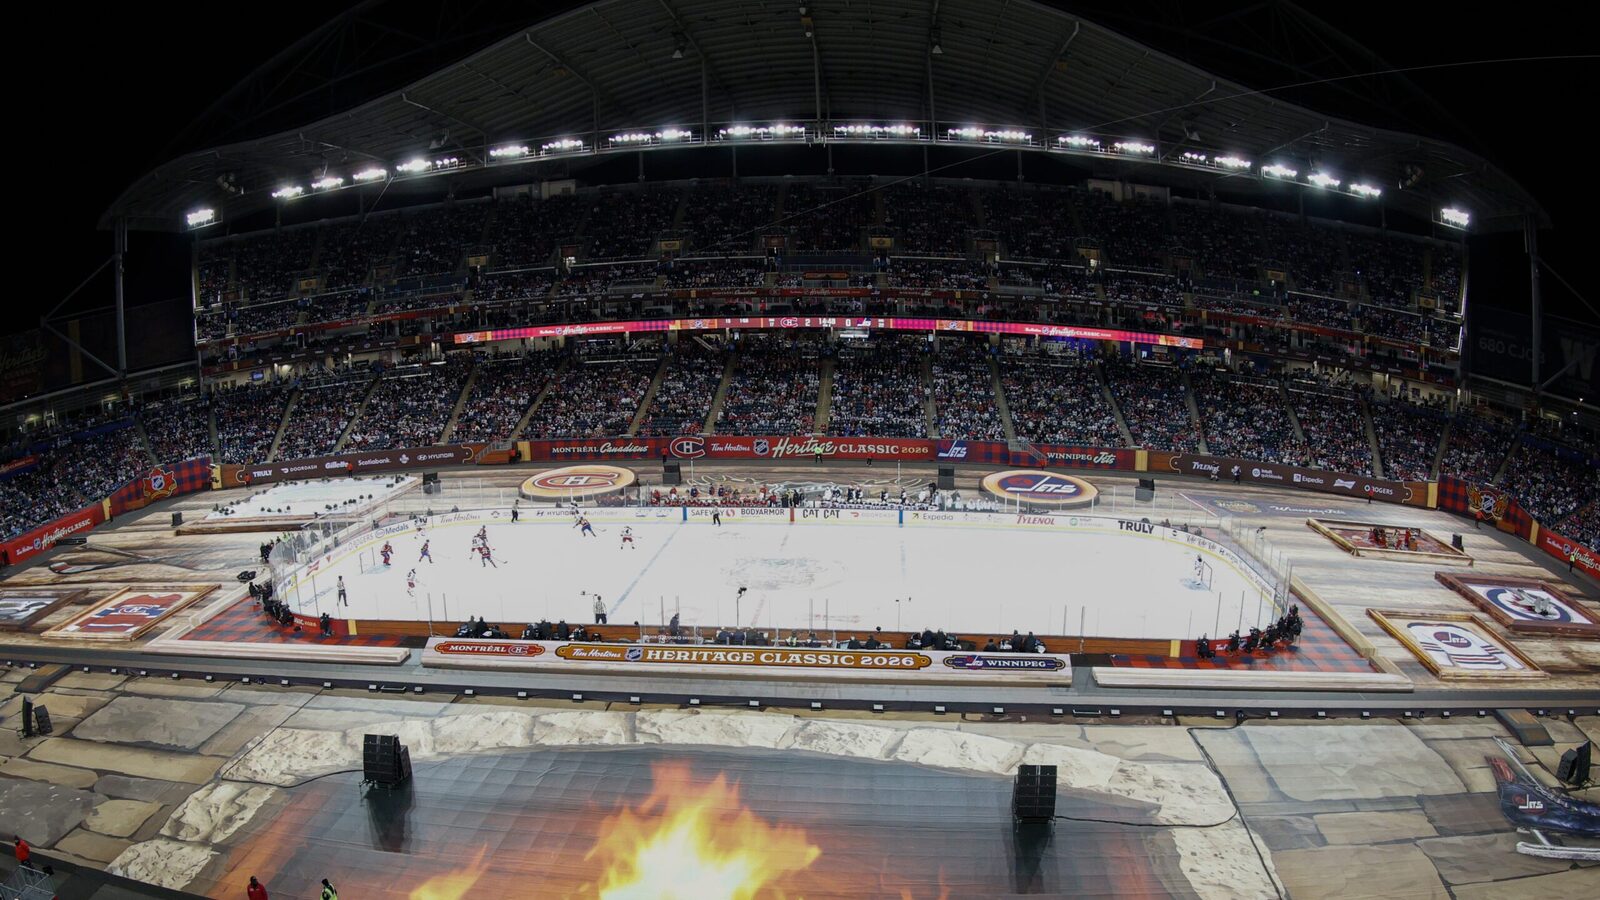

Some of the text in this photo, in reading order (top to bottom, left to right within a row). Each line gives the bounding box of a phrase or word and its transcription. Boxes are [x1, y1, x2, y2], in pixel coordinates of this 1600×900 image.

[805, 318, 811, 327] 2
[599, 442, 648, 454] Canadiens
[711, 437, 929, 458] Tim Hortons Heritage CLASSIC 2026
[427, 452, 454, 461] HYUNDAI
[1047, 450, 1117, 465] WINNIPEG Jets
[358, 457, 391, 467] Scotiabank
[252, 468, 273, 478] TRULY
[1302, 474, 1324, 484] Expedia
[740, 508, 785, 517] BODYARMOR
[802, 508, 841, 519] CAT CAT
[923, 513, 954, 522] Expedia
[1016, 514, 1055, 526] TYLENOL
[67, 518, 91, 534] CLASSIC
[385, 523, 409, 536] Medals
[1118, 520, 1155, 535] TRULY
[449, 643, 507, 653] MONTRÉAL
[571, 648, 915, 668] Tim Hortons HERITAGE CLASSIC 2026
[985, 659, 1046, 668] WINNIPEG
